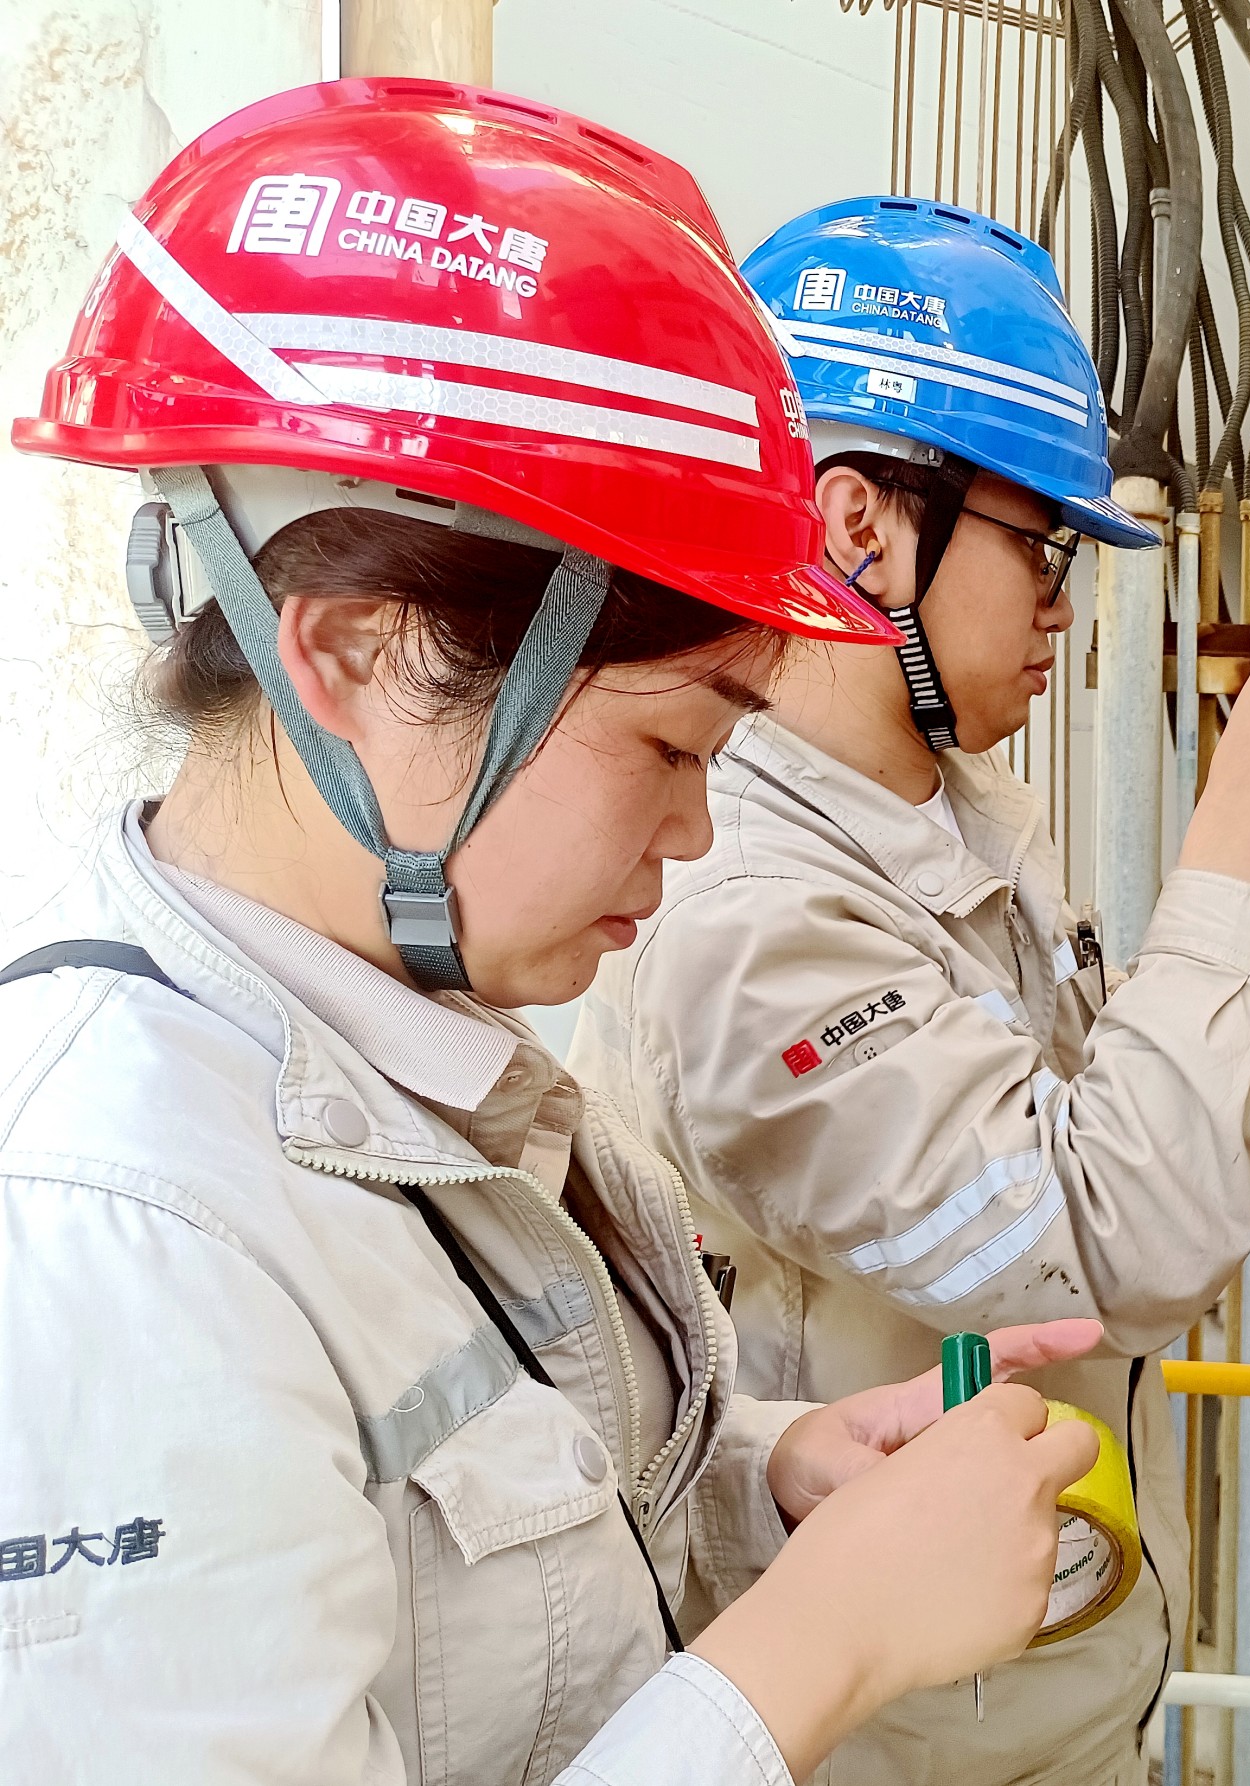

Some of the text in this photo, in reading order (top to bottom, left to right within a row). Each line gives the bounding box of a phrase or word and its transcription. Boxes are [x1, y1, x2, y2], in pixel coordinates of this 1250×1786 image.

[345, 190, 549, 273] 中国大唐
[337, 228, 538, 298] CHINA DATANG
[851, 302, 944, 328] CHINA DATANG
[853, 283, 946, 316] 中国大唐
[820, 989, 906, 1046] 中国大唐
[0, 1516, 167, 1582] 国大唐
[1052, 1549, 1094, 1585] NDEHAO
